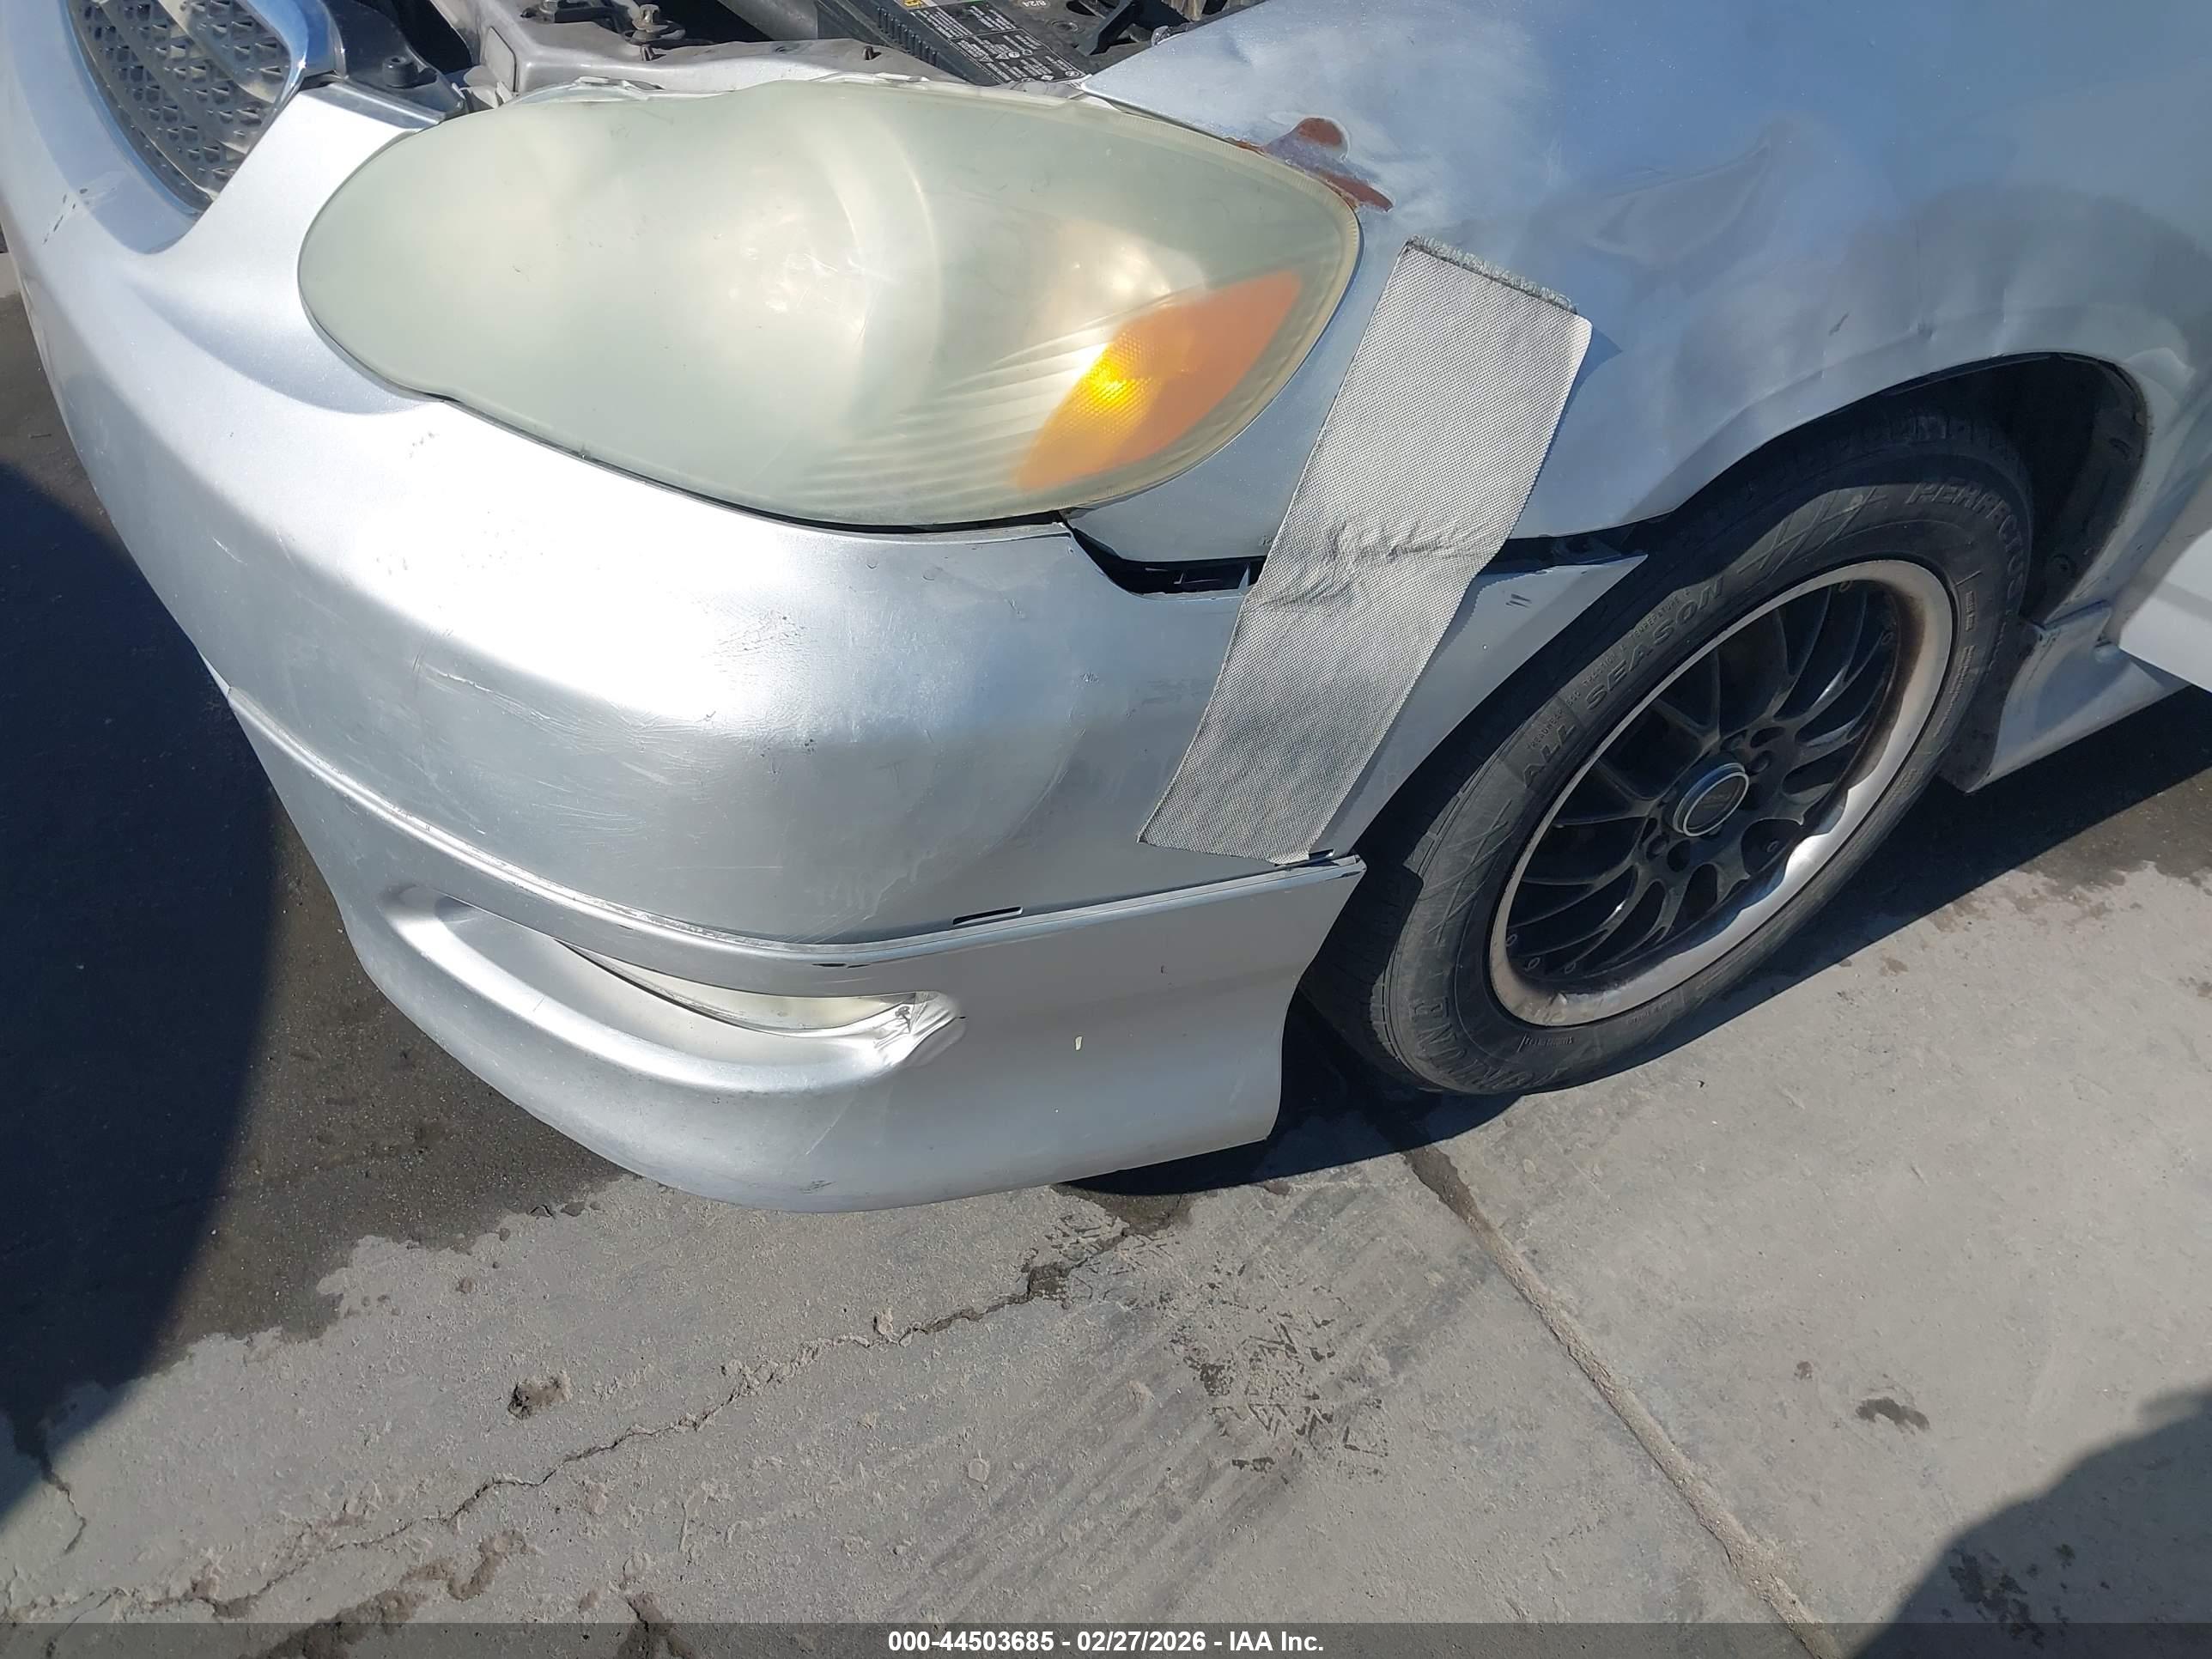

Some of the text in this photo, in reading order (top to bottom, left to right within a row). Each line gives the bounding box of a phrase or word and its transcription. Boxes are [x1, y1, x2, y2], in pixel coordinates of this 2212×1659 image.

[1522, 576, 1725, 785] ALL SEASON
[1526, 707, 1564, 750] TREADWEAR
[1582, 653, 1618, 687] TRACTION
[1628, 596, 1680, 640] TEMPERATURE
